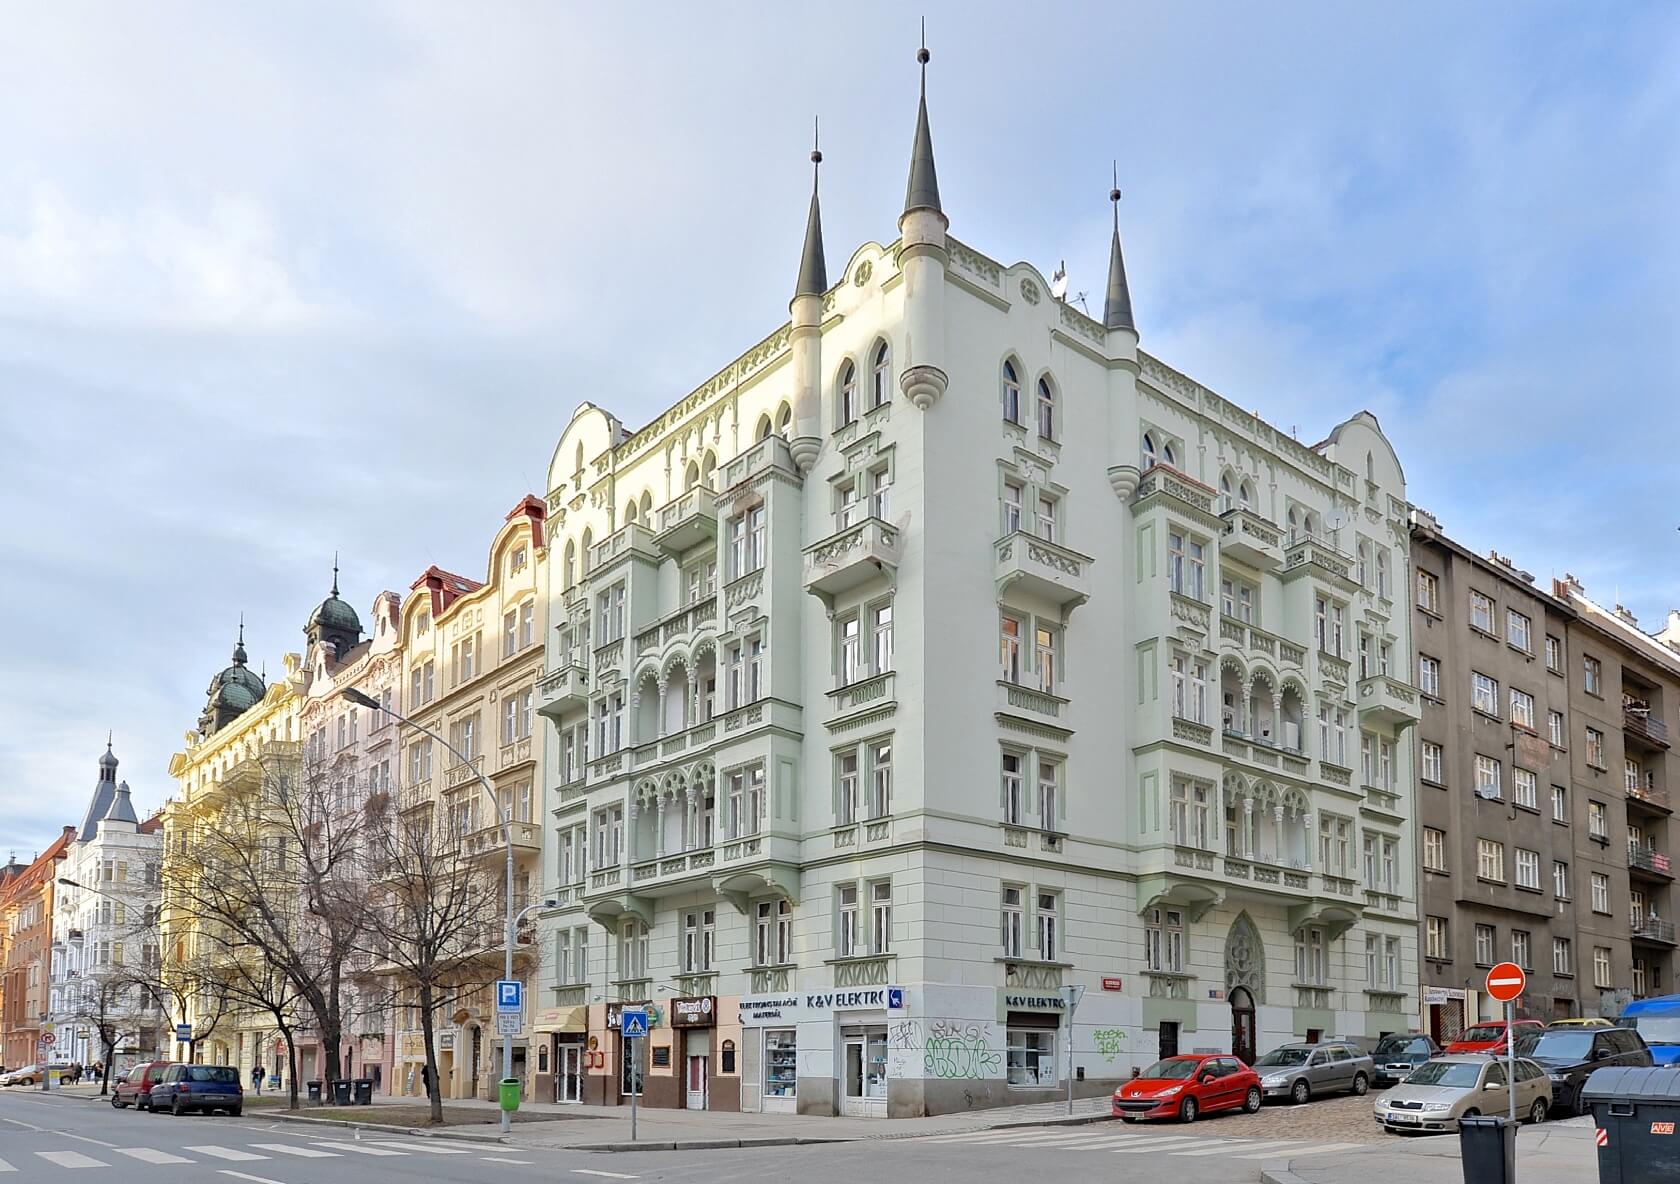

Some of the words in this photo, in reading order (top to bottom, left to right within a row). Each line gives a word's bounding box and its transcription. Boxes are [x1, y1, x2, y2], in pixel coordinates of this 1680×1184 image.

[502, 984, 516, 1003] P
[806, 994, 833, 1008] K&V
[1006, 995, 1026, 1007] K&V
[1027, 997, 1066, 1009] ELEKTRO
[1651, 1122, 1675, 1134] AVE
